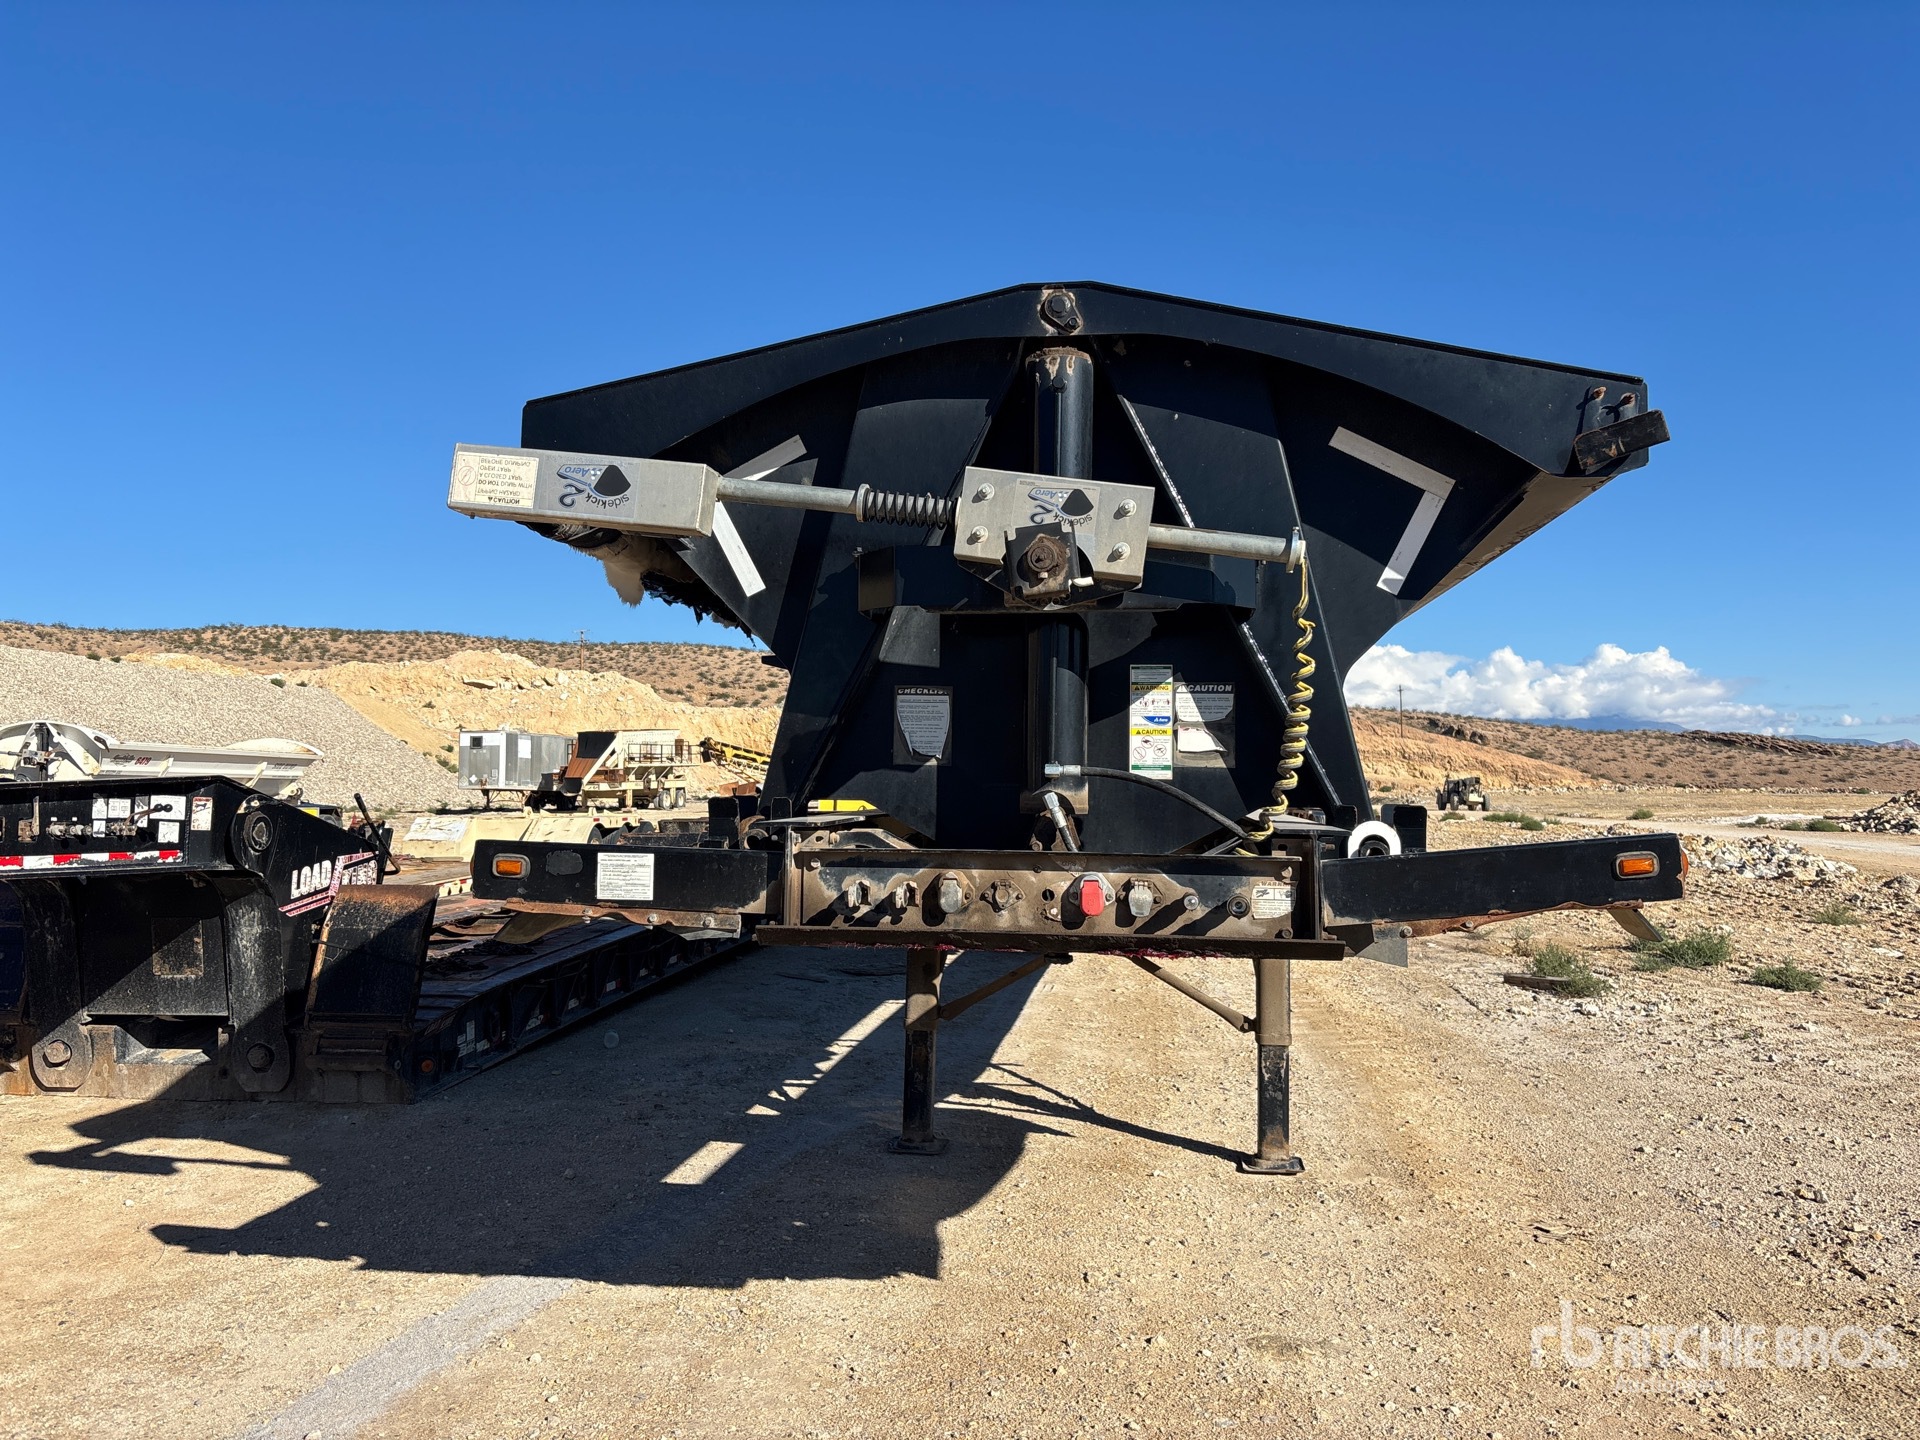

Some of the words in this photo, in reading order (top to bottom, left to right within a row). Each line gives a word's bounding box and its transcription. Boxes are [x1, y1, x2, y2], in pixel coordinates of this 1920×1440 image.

[564, 466, 590, 477] Aero
[1034, 489, 1057, 499] Aero
[585, 492, 630, 510] sidekick
[1053, 512, 1093, 527] sidekick
[1188, 684, 1233, 692] CAUTION
[290, 859, 333, 900] LOAD
